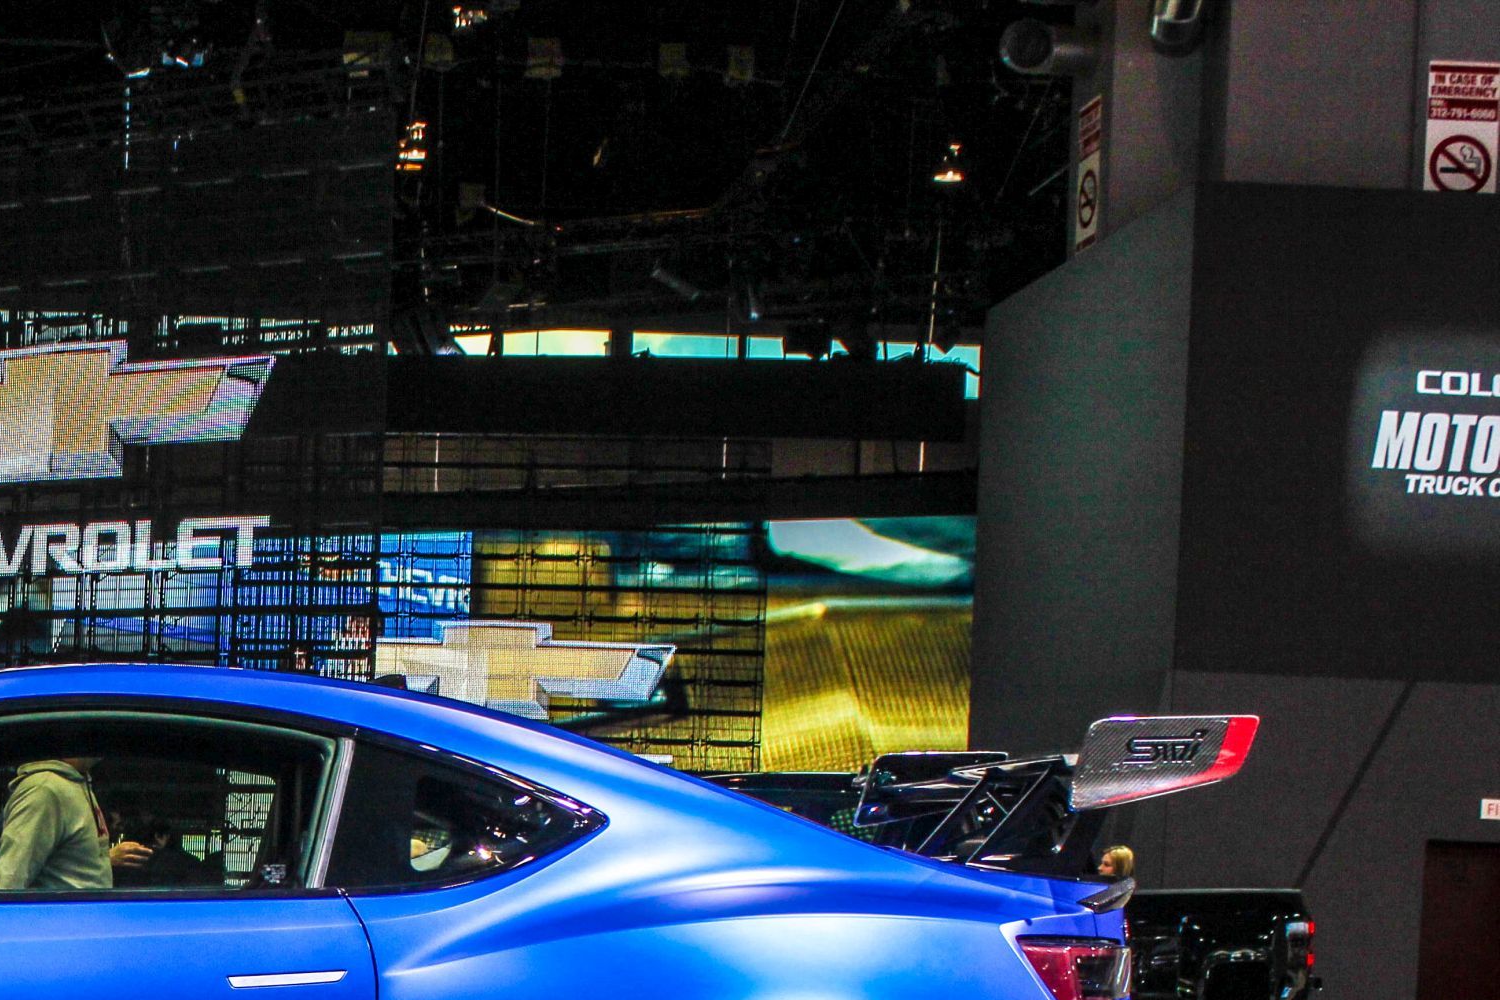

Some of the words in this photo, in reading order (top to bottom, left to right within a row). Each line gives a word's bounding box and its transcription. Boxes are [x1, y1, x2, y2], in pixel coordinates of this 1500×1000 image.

[1449, 74, 1477, 85] CASE
[1431, 85, 1497, 98] EMERGENCY
[1416, 370, 1500, 397] COL
[1405, 474, 1487, 496] TRUCK
